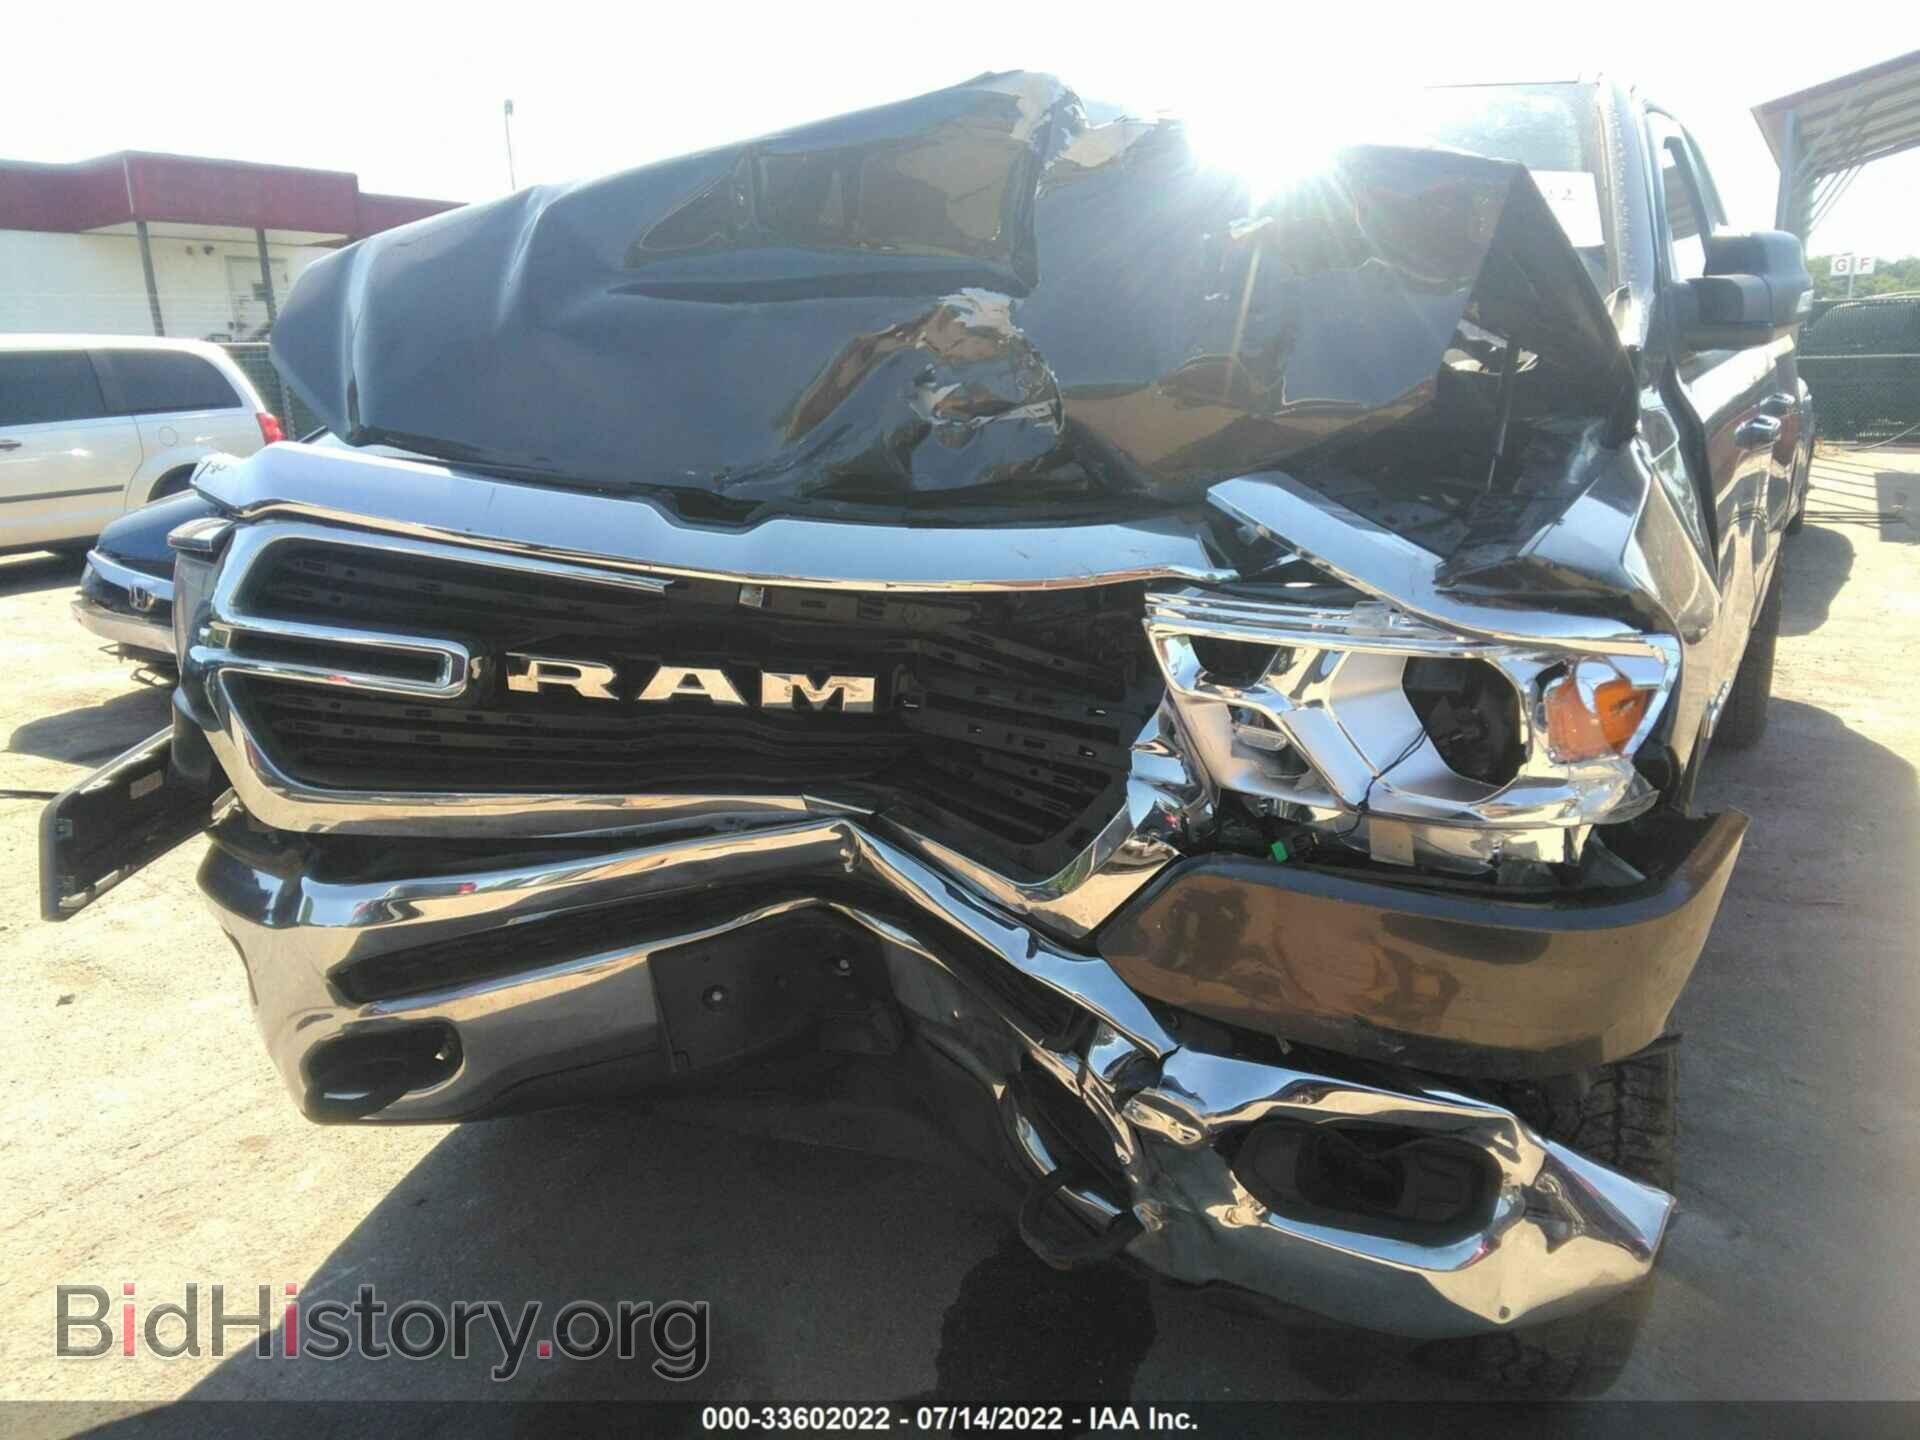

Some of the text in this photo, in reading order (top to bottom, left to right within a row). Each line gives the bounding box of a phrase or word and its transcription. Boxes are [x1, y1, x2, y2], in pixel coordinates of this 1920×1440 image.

[1835, 258, 1848, 272] G
[1860, 257, 1871, 271] F
[506, 652, 875, 712] RAM
